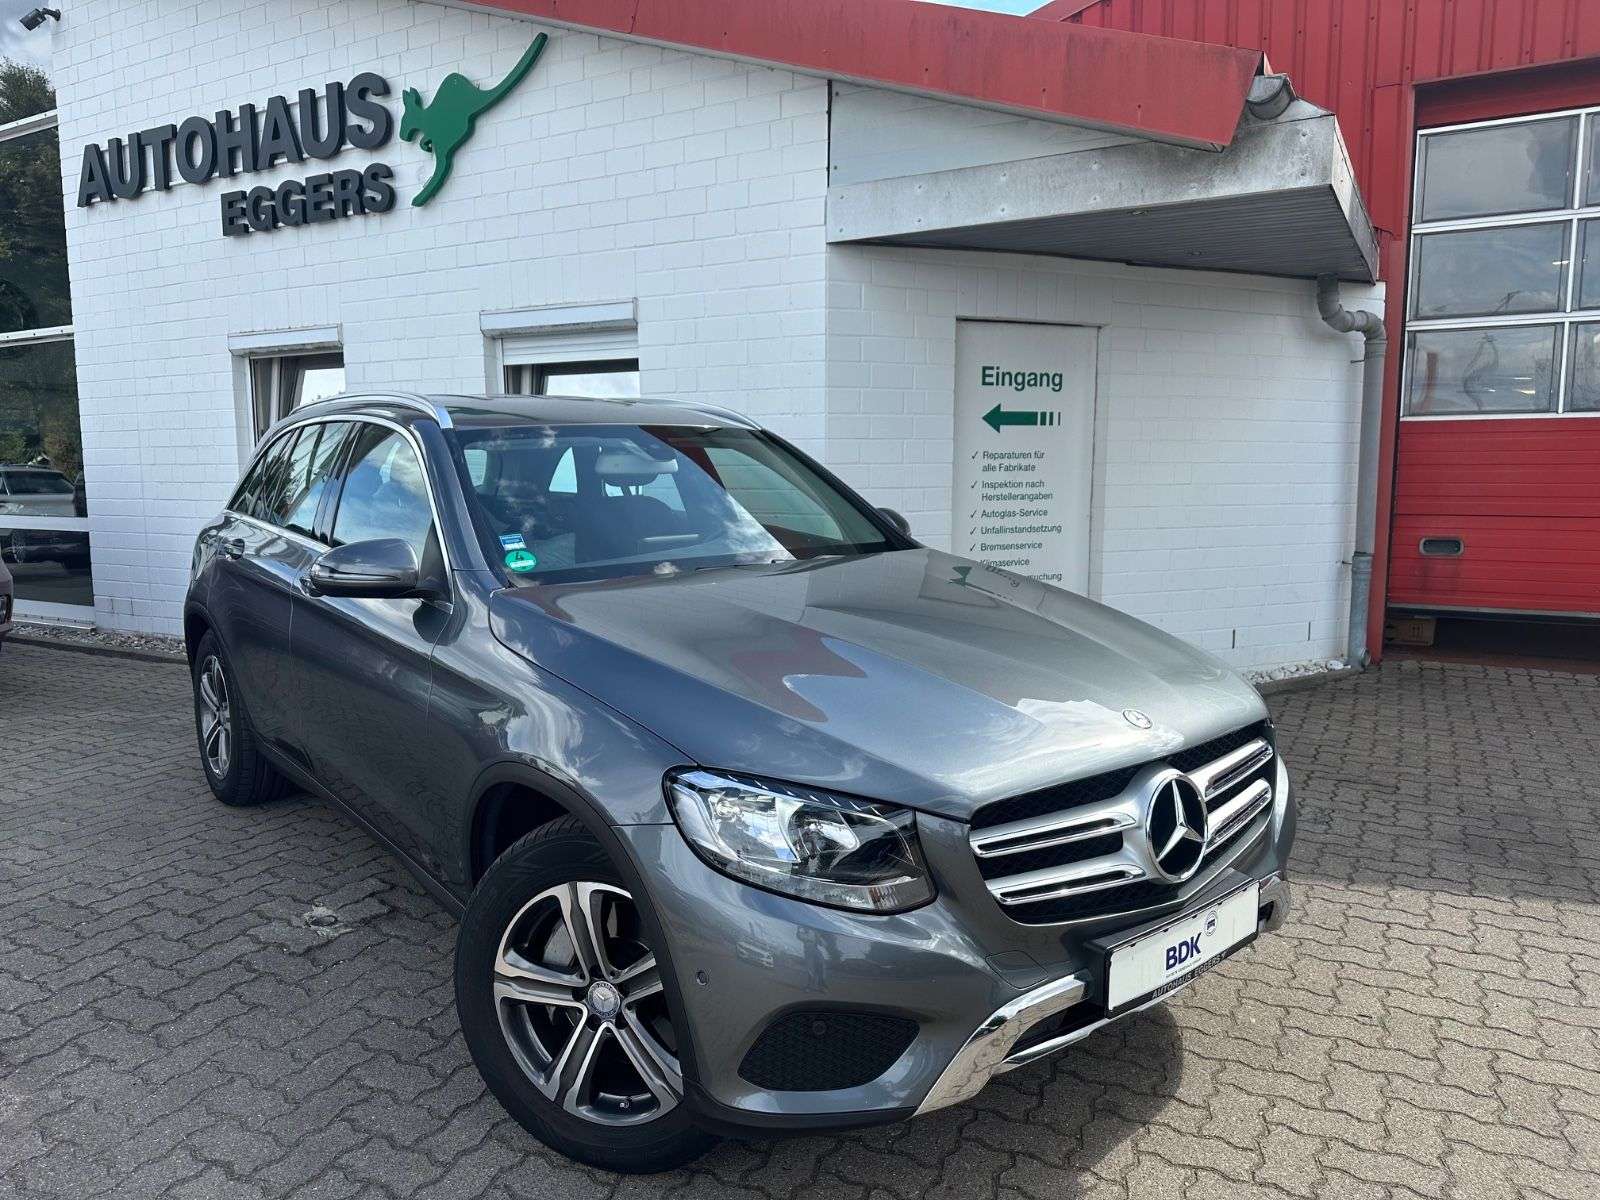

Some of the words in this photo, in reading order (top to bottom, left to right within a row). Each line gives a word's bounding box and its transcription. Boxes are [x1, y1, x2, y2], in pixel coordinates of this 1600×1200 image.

[77, 72, 393, 207] AUTOHAUS
[220, 162, 396, 236] EGGERS
[981, 366, 1063, 391] Eingang
[982, 451, 1032, 460] Reparaturen
[1034, 450, 1045, 459] für
[982, 463, 997, 472] alle
[998, 463, 1036, 472] Fabrikate
[982, 480, 1023, 490] Inspektion
[1025, 480, 1045, 488] nach
[981, 491, 1053, 502] Herstellerangaben
[981, 509, 1048, 519] Autoglas-Service
[980, 524, 1062, 534] Unfallinstandsetzung
[980, 541, 1043, 551] Bremsenservice
[1166, 932, 1202, 970] BDK
[1152, 974, 1192, 999] AUTOHAUS
[1194, 954, 1222, 977] EGGERS
